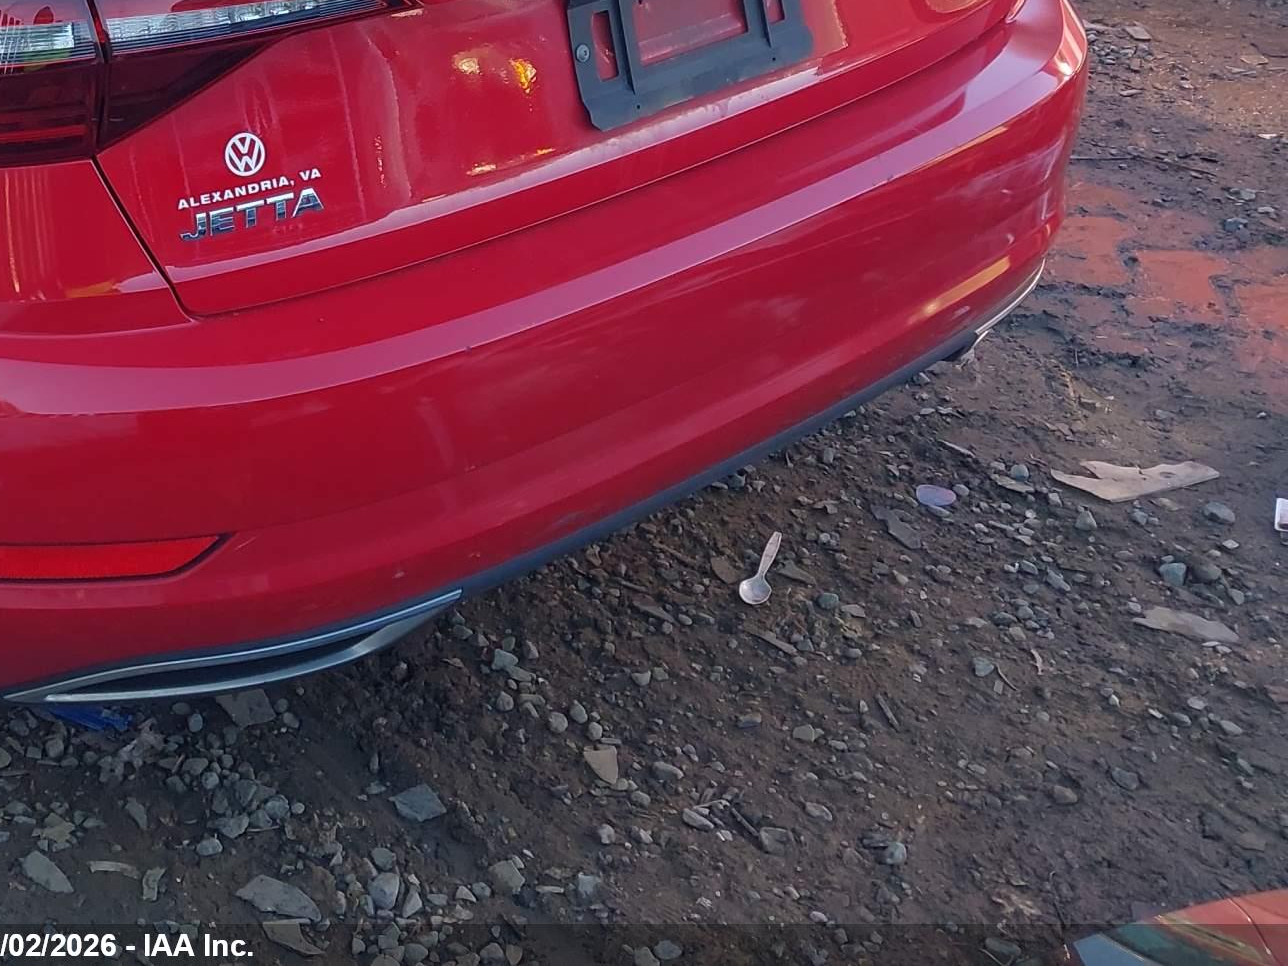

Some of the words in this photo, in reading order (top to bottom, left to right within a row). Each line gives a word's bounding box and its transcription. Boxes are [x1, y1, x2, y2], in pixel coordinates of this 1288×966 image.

[177, 175, 296, 211] ALEXANDRIA,
[299, 167, 322, 182] VA
[179, 187, 325, 241] JETTA
